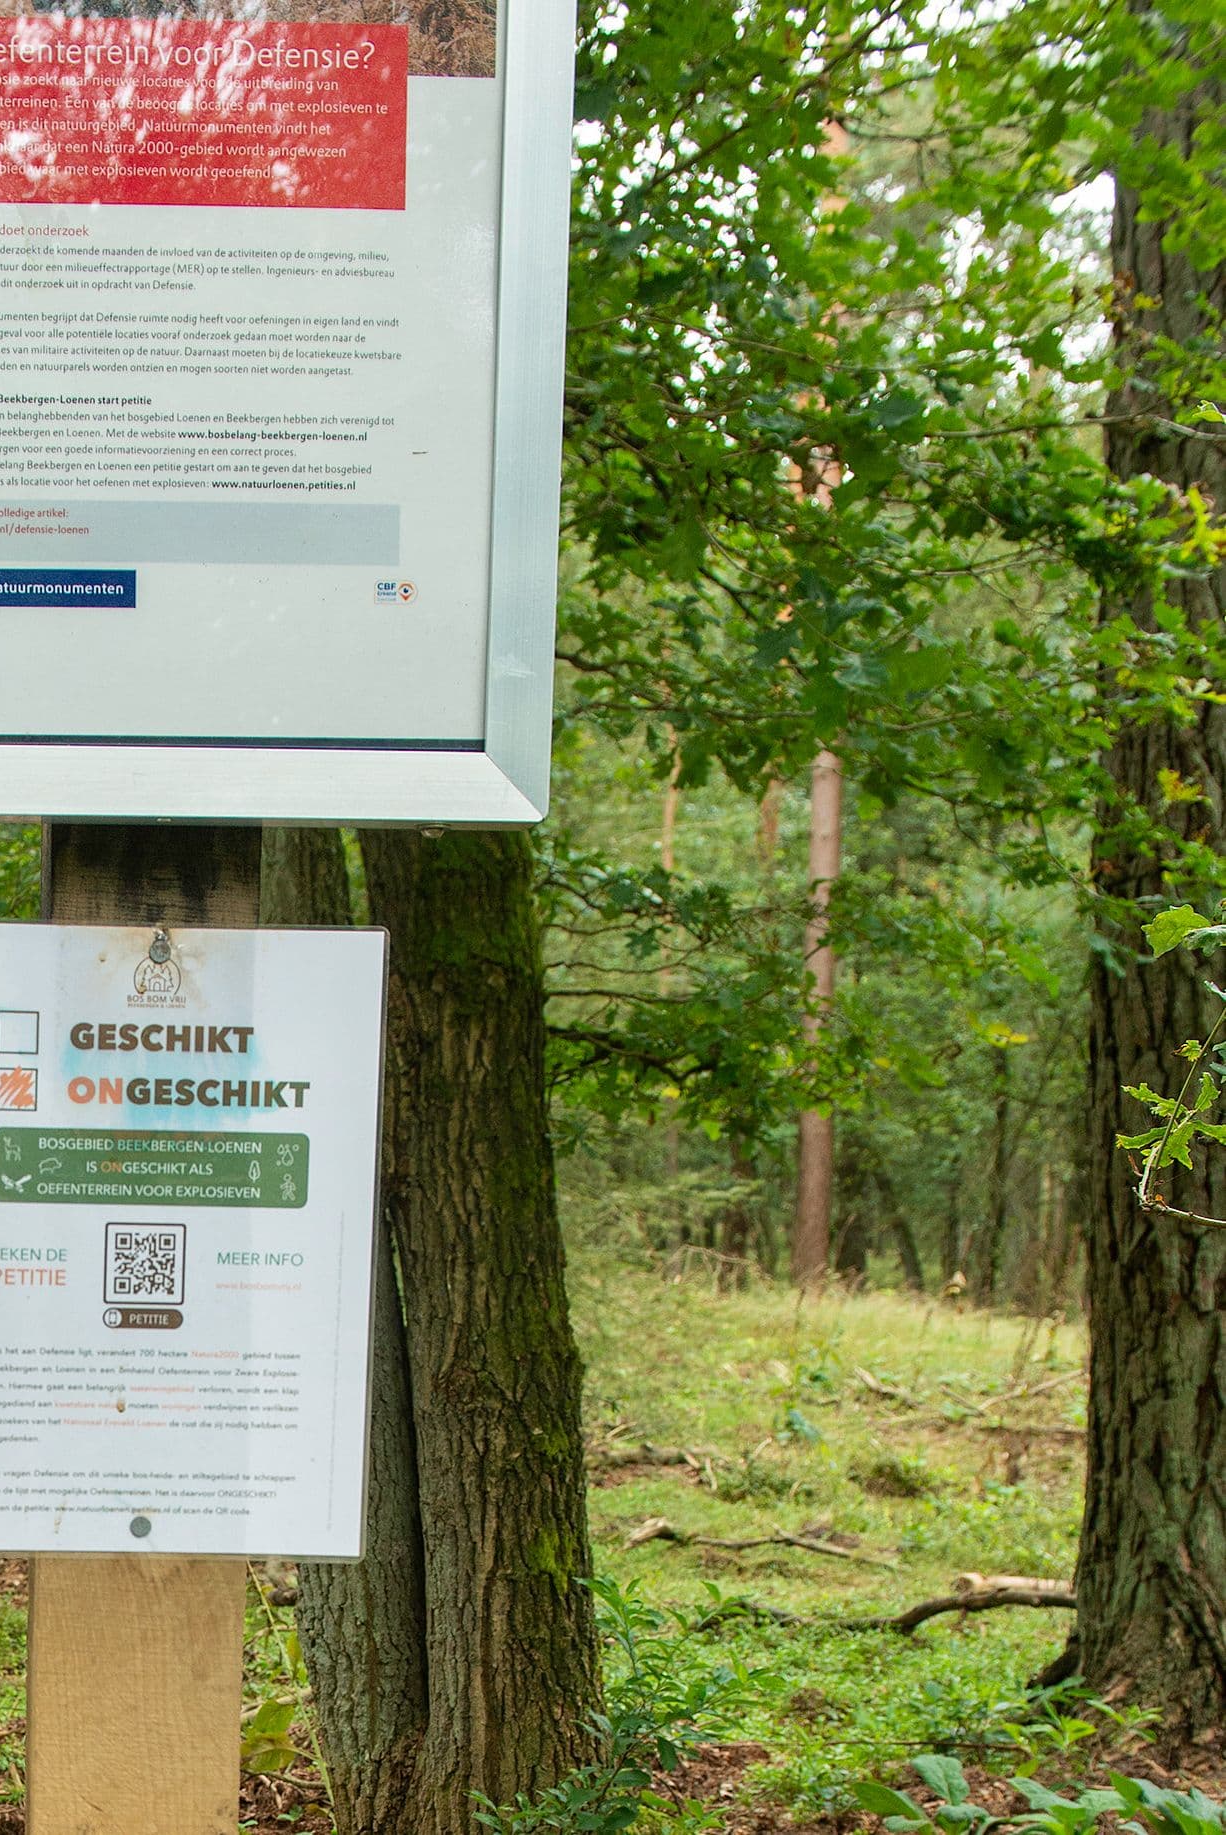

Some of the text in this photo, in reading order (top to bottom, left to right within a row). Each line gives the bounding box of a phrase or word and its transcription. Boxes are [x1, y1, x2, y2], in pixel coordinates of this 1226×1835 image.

[158, 45, 224, 66] voor
[233, 39, 375, 69] Defensie?
[244, 78, 339, 94] uitbreiding van
[298, 101, 388, 115] explosieven te
[18, 118, 28, 130] is
[31, 117, 48, 131] dit
[52, 118, 138, 135] natuurgebied.
[142, 120, 273, 134] Natuurmonumenten
[275, 122, 308, 135] vindt
[311, 122, 331, 135] het
[65, 141, 347, 160] een Natura 2000-gebied wordt aangewezen
[65, 163, 274, 179] met explosieven wordt geoefend.
[26, 223, 89, 237] onderzoek
[0, 278, 12, 288] dit
[14, 277, 64, 289] onderzoek
[65, 279, 78, 289] uit
[80, 279, 90, 289] in
[90, 278, 132, 292] opdracht
[133, 281, 151, 290] van
[152, 279, 196, 290] Defensie.
[40, 311, 78, 325] begrijpt
[78, 311, 94, 322] dat
[95, 312, 137, 323] Defensie
[138, 314, 169, 323] ruimte
[170, 313, 198, 327] nodig
[97, 396, 119, 405] start
[120, 396, 152, 407] petitie
[52, 429, 64, 437] en
[65, 427, 103, 438] Loenen.
[105, 427, 125, 438] Met
[126, 427, 139, 438] de
[140, 428, 176, 439] website
[177, 428, 367, 444] www.bosbelang-beekbergen-loenen.nl
[6, 476, 19, 486] als
[20, 476, 51, 486] locatie
[52, 478, 73, 487] voor
[75, 476, 90, 487] het
[92, 477, 130, 487] oefenen
[132, 479, 150, 487] met
[151, 478, 209, 490] explosieven:
[210, 478, 356, 491] www.natuurloenen.petities.nl
[36, 507, 69, 518] artikel:
[377, 582, 397, 591] CBF
[126, 994, 186, 1005] BOS BOM VRIJ
[69, 1022, 254, 1054] GESCHIKT
[66, 1076, 310, 1108] ONGESCHIKT
[38, 1136, 262, 1154] BOSGEBIED BEEKBERGEN-LOENEN
[85, 1160, 213, 1176] IS ONGESCHIKT ALS
[36, 1182, 261, 1199] OEFENTERREIN VOOR EXPLOSIEVEN
[45, 1247, 67, 1262] DE
[216, 1251, 304, 1267] MEER INFO
[128, 1313, 169, 1325] PETITIE
